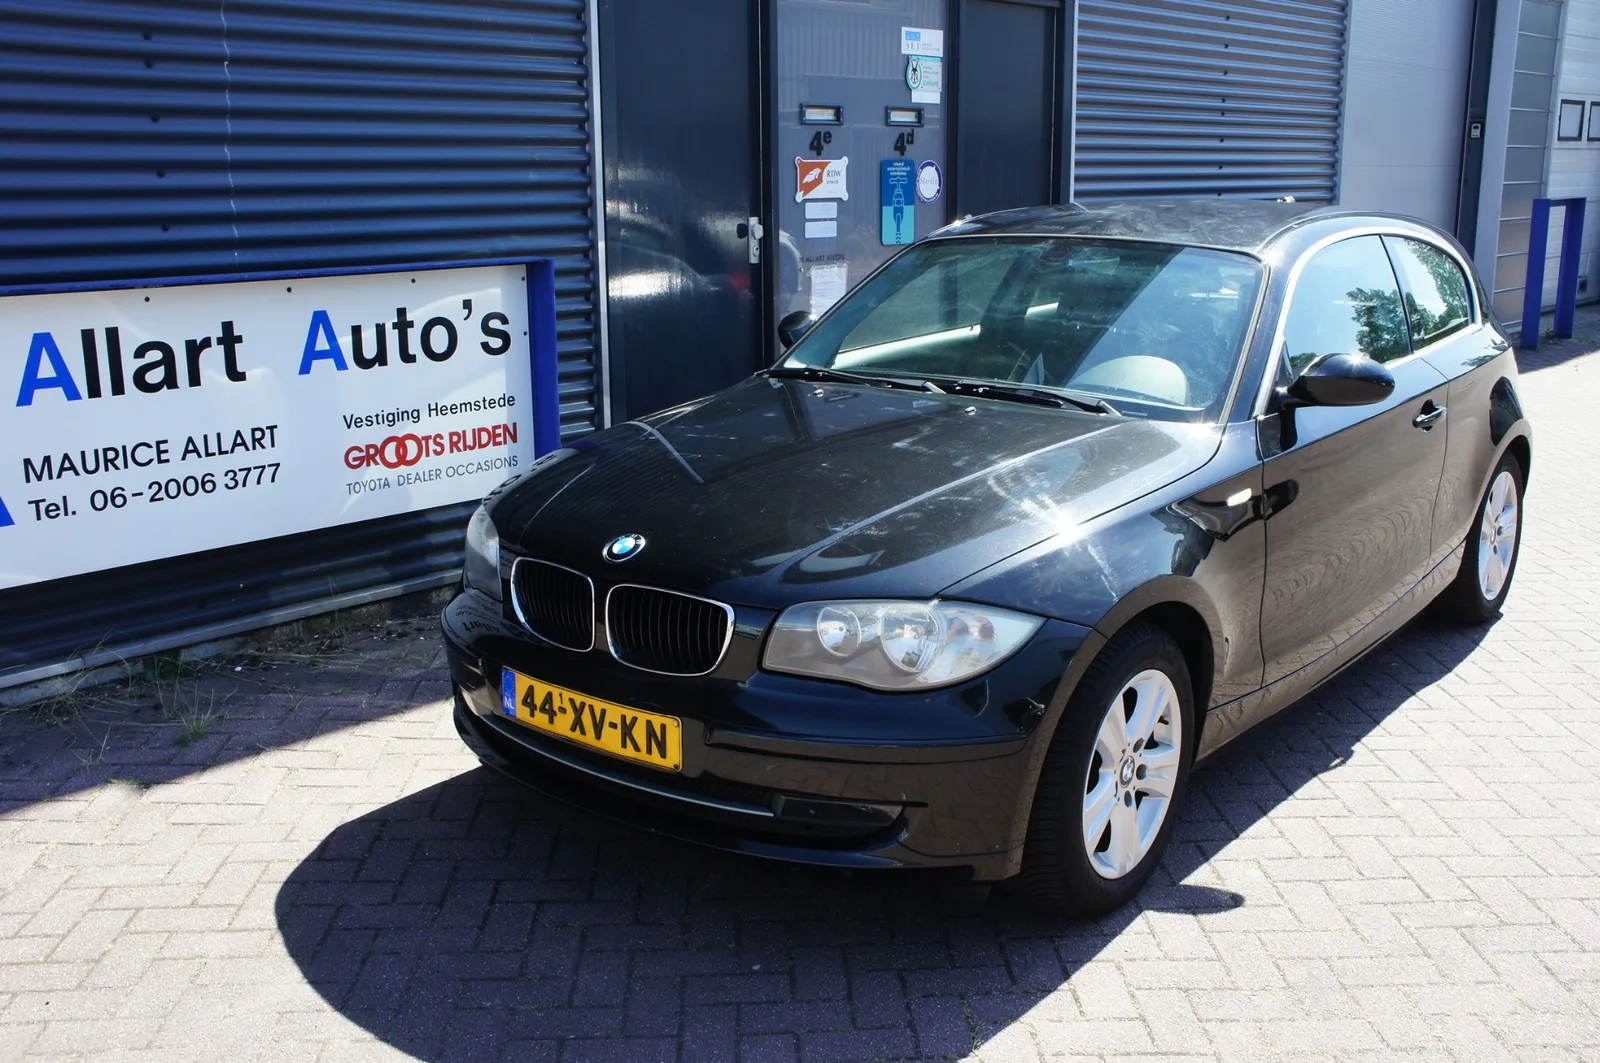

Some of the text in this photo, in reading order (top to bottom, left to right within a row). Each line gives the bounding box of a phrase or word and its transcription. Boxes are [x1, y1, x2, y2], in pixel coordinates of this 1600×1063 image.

[809, 130, 832, 156] 4e
[893, 128, 914, 156] 4d
[826, 168, 842, 177] RDW
[16, 299, 512, 408] Allart Auto's
[343, 393, 516, 430] Vestiging Heemstede
[23, 424, 278, 483] MAURICE ALLART
[344, 421, 518, 470] GROOTS RIJDEN
[28, 494, 77, 522] Tel.
[90, 472, 217, 512] 06-2006
[224, 462, 281, 491] 3777
[346, 454, 519, 496] TOYOTA DEALER OCCASIONS
[503, 695, 515, 710] NL
[521, 684, 668, 760] 44-XV-KN
